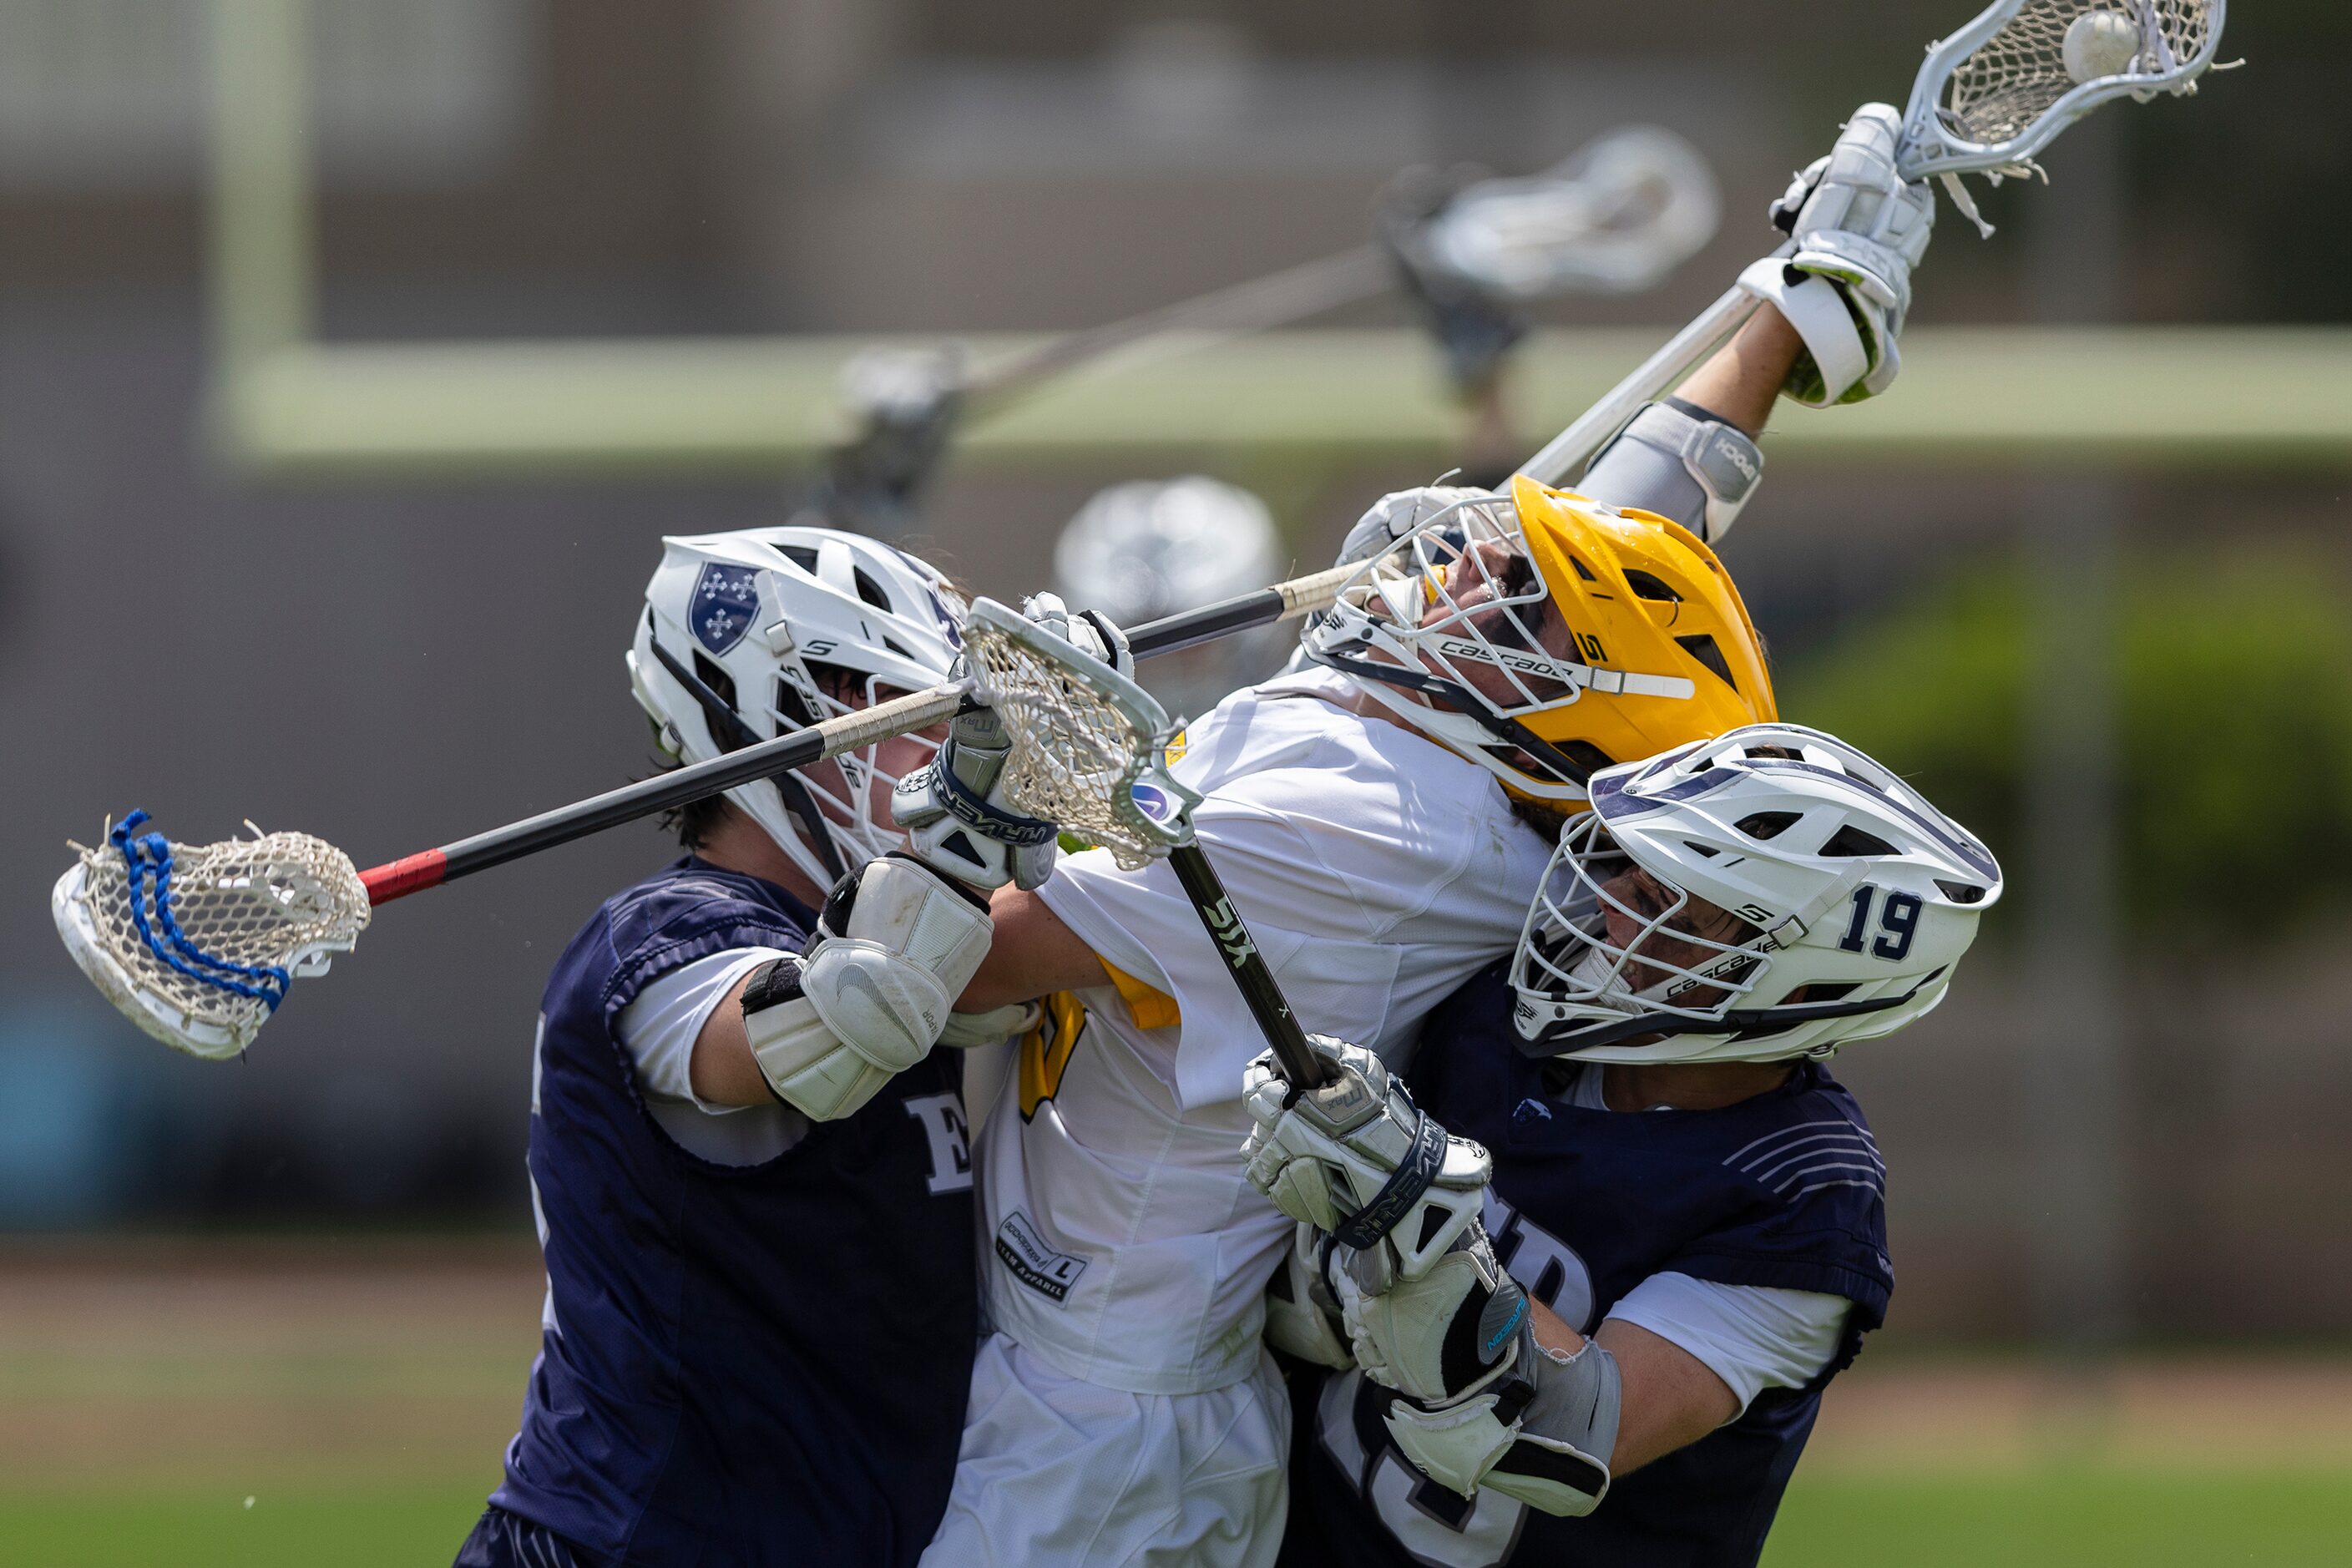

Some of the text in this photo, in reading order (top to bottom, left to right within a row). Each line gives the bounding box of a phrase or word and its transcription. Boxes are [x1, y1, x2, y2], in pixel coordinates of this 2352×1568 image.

[1202, 895, 1257, 969] STX
[1838, 883, 1924, 963] 19
[1667, 940, 1778, 998] cascade
[922, 1008, 938, 1037] VAPOR
[1355, 1119, 1447, 1243] MAVERIK
[1017, 1267, 1062, 1297] APPAREL
[1055, 1260, 1070, 1279] L
[1487, 1295, 1526, 1351] SURGEON
